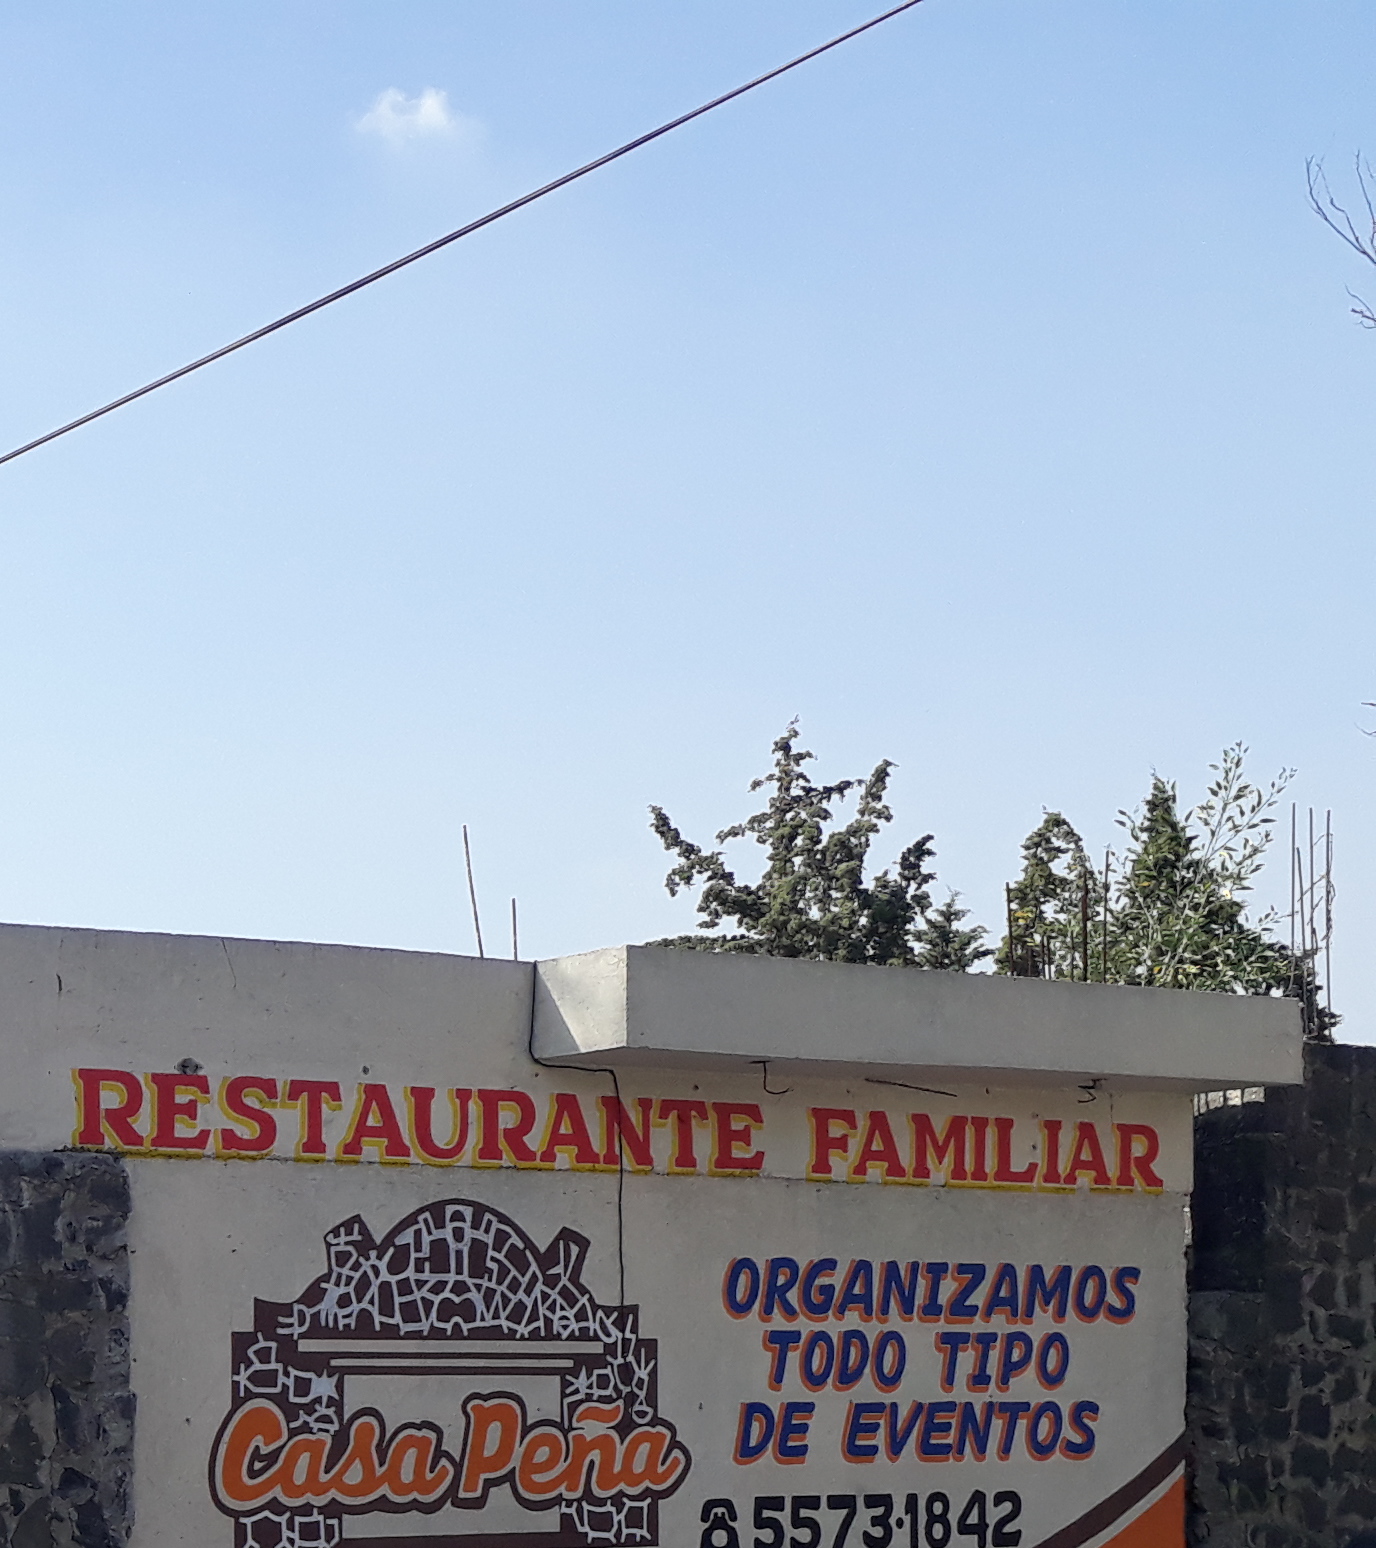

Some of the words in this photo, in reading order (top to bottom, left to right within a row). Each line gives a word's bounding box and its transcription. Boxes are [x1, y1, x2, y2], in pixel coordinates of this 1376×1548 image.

[71, 1068, 764, 1177] RESTAURANTE
[807, 1107, 1163, 1194] FAMILIAR
[722, 1257, 1142, 1324] ORGANIZAMOS
[762, 1330, 907, 1392] TODO
[935, 1331, 1070, 1392] TIPO
[221, 1405, 454, 1502] Casa
[458, 1397, 687, 1501] Peña
[732, 1402, 816, 1466] DE
[841, 1400, 1100, 1464] EVENTOS
